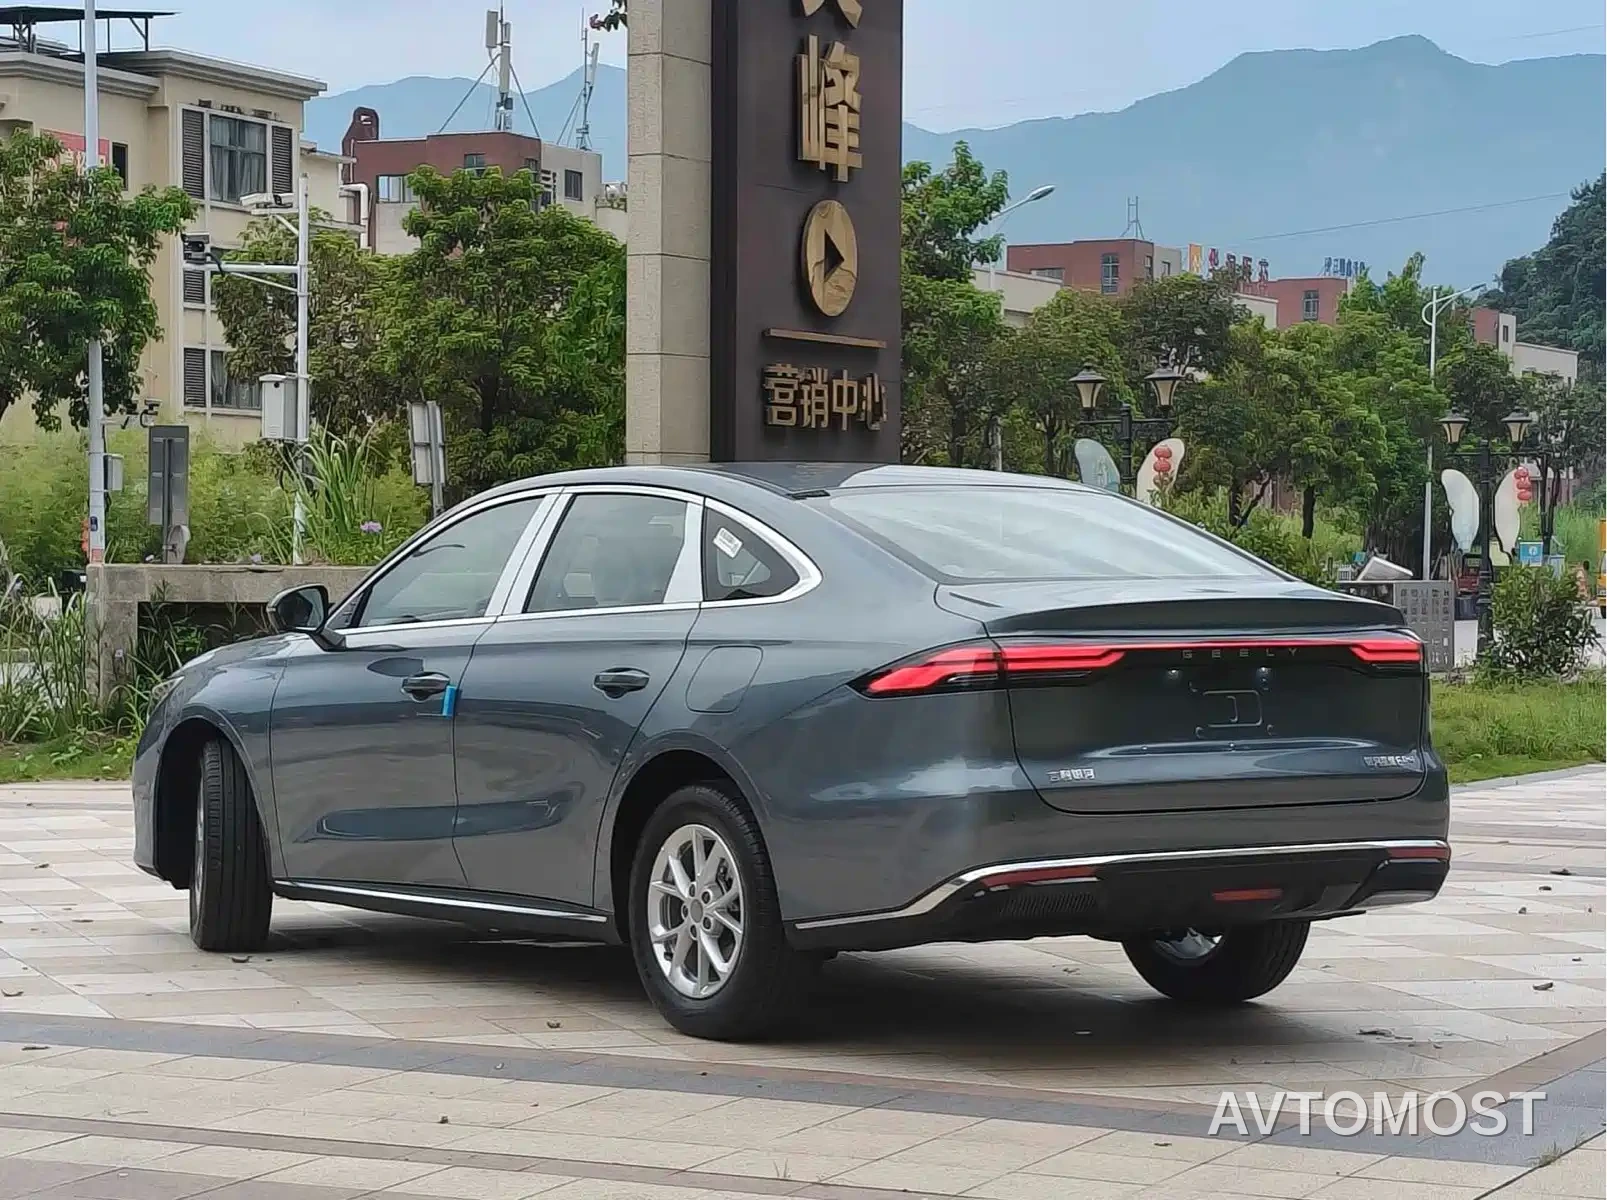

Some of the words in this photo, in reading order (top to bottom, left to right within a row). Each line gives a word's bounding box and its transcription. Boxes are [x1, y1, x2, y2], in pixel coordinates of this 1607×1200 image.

[763, 363, 887, 431] 营销中心
[1182, 648, 1298, 659] GEELY
